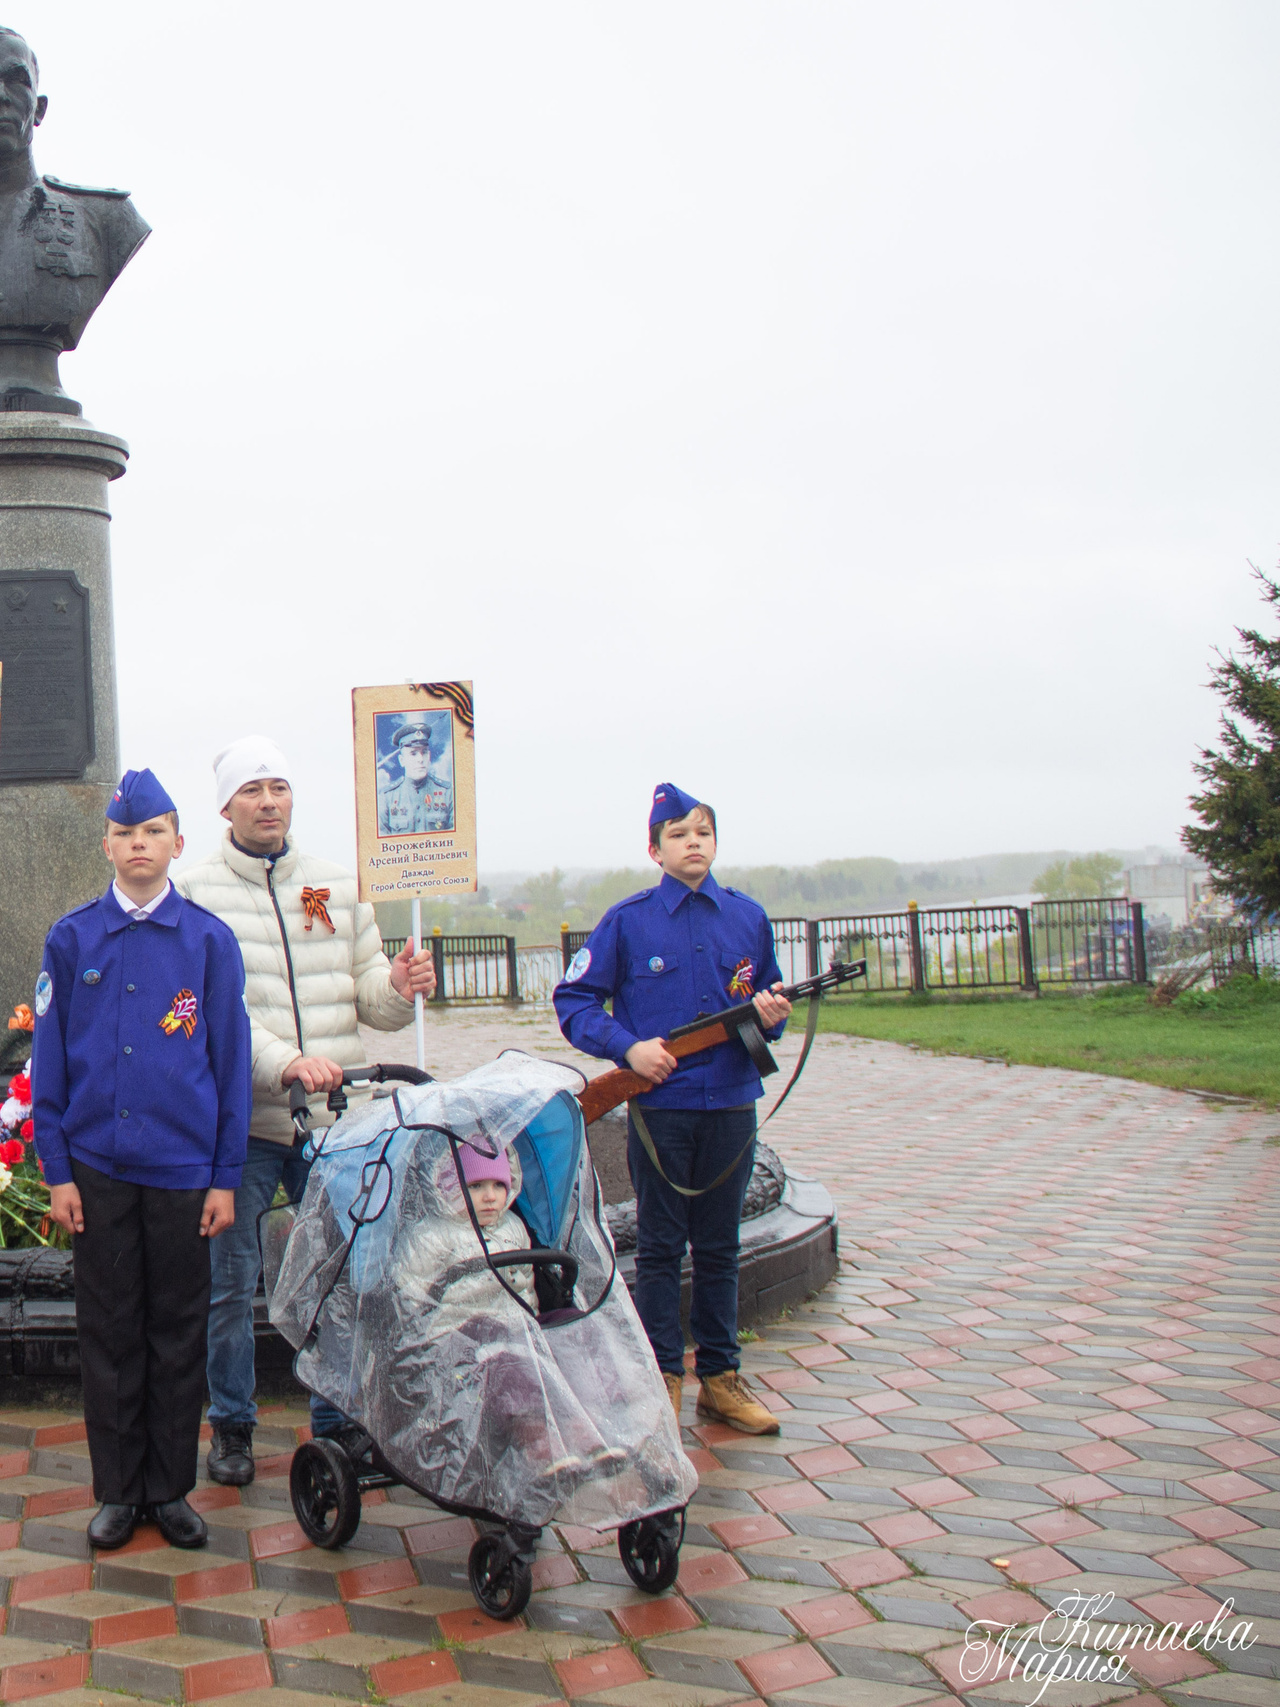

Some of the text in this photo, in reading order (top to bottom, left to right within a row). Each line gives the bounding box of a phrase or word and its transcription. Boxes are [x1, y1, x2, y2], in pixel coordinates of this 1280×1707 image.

[381, 839, 454, 854] Ворожейкин
[368, 850, 468, 868] Арсений Васильевич
[401, 868, 434, 879] Дважды
[370, 876, 468, 892] Герой Советского Союза
